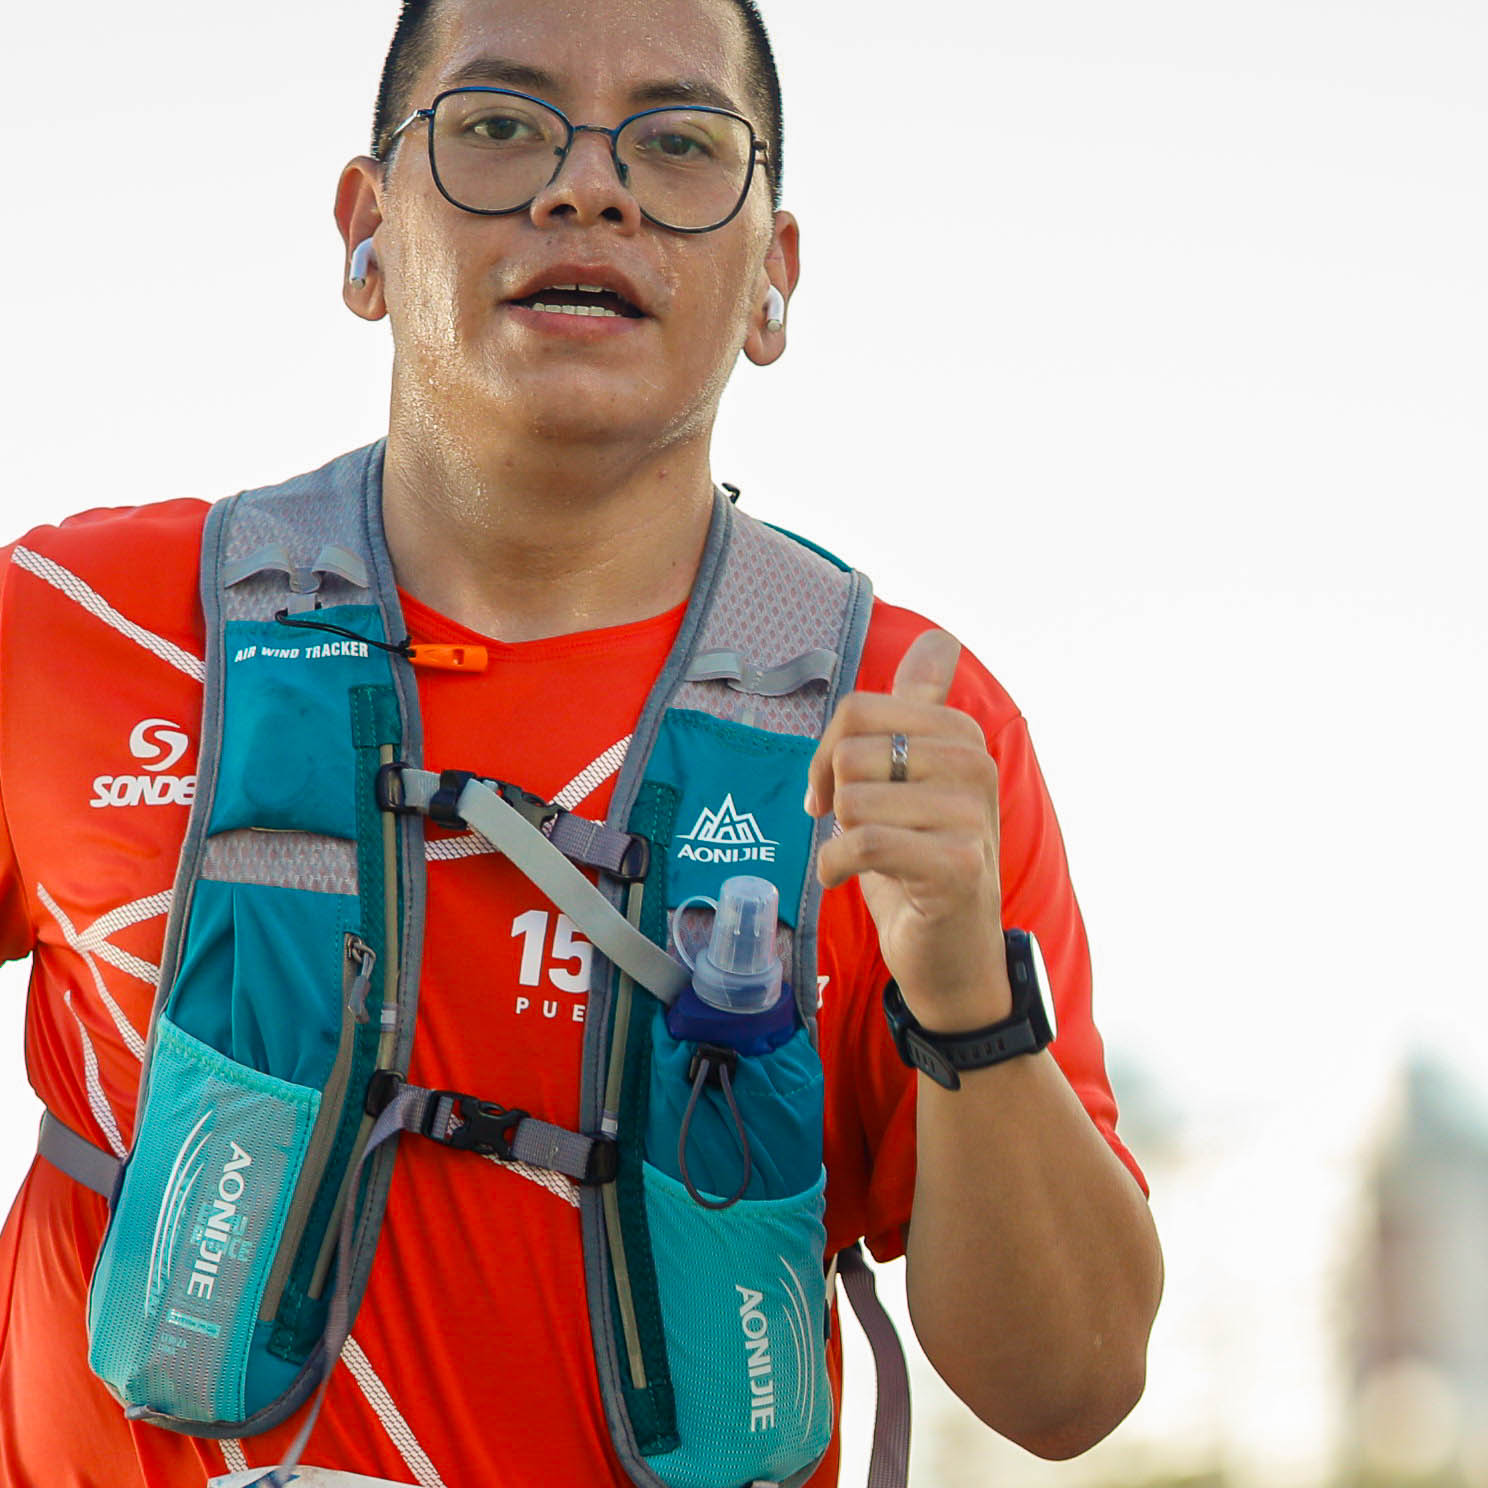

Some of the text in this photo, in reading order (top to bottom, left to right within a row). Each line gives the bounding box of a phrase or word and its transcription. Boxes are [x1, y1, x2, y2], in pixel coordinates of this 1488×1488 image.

[234, 641, 369, 662] AIR WIND TRACKER
[677, 844, 776, 863] AONIJIE
[515, 997, 587, 1022] PUE
[187, 1141, 253, 1300] AONIJIE
[736, 1284, 775, 1433] AONIJIE
